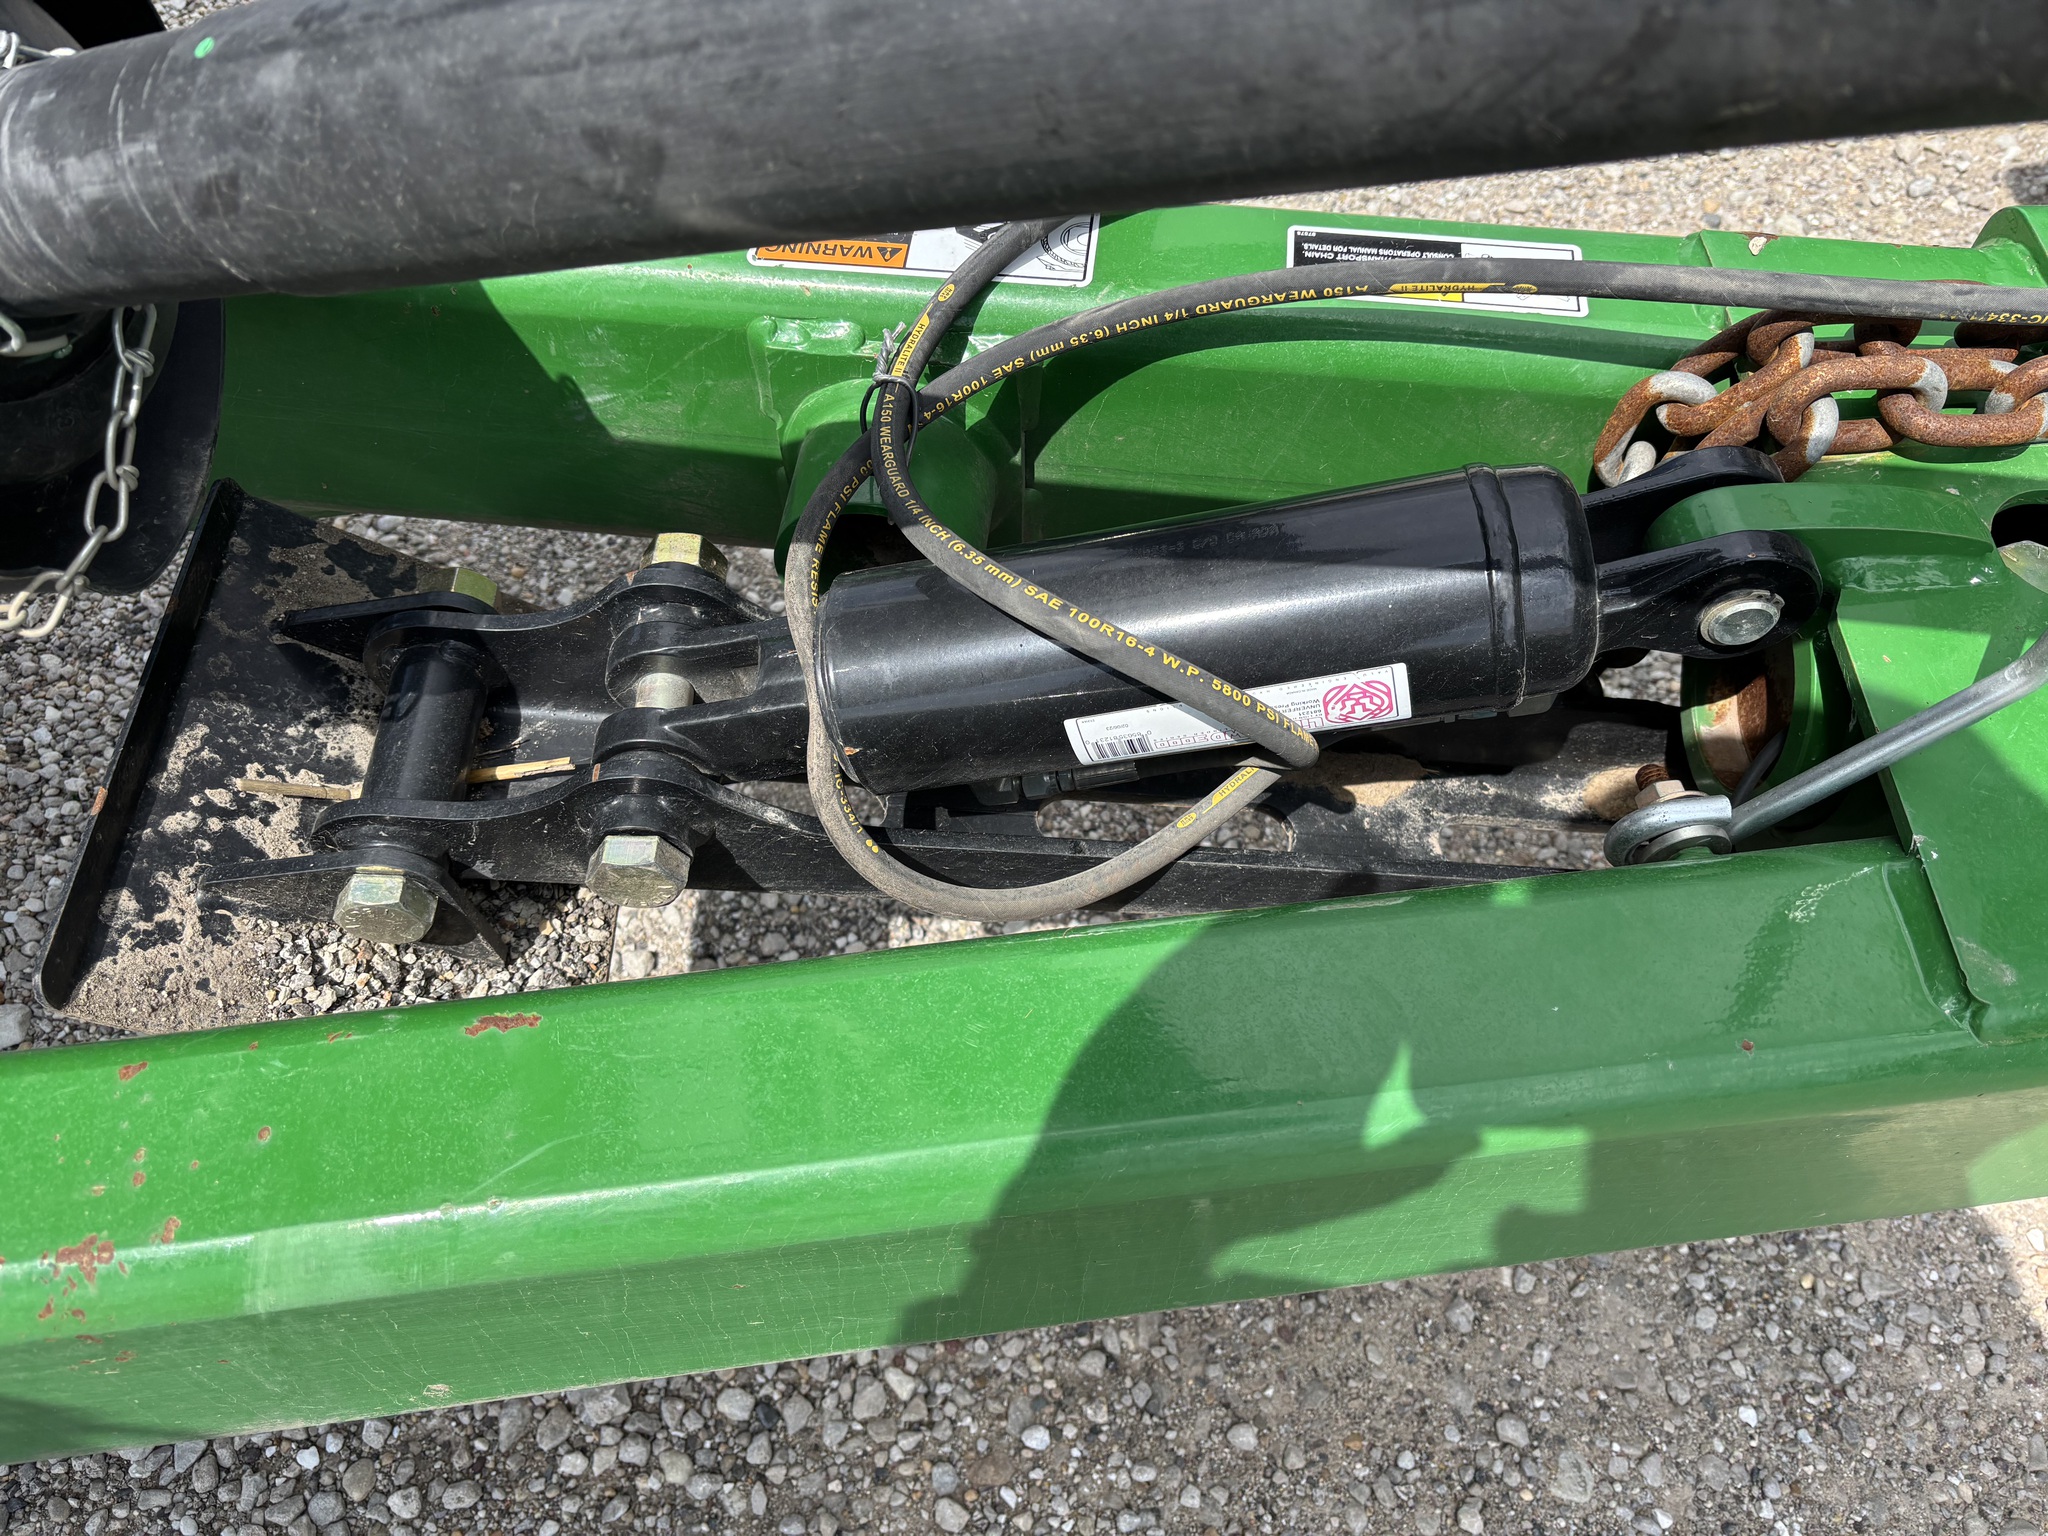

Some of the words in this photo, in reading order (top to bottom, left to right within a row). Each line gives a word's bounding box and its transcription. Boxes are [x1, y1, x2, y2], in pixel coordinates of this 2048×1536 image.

[1302, 243, 1332, 252] DETAILS.
[1333, 245, 1348, 253] FOR
[1349, 246, 1378, 255] MANUAL
[1379, 248, 1421, 258] OPERATORS
[1412, 284, 1476, 292] HYDRALITE
[1164, 308, 1189, 322] 1/4
[1195, 289, 1317, 316] WEARGUARD
[1070, 325, 1110, 348] (6.35
[1116, 314, 1159, 334] INCH
[896, 322, 926, 366] HYDRALITE
[1029, 341, 1065, 362] mm)
[991, 356, 1025, 380] SAE
[880, 393, 895, 423] A150
[923, 375, 988, 421] 100R16-4
[879, 426, 910, 498] WEARGUARD
[843, 475, 859, 503] PSI
[905, 499, 924, 515] 1/4
[815, 501, 842, 555] FLAME
[918, 515, 952, 541] INCH
[947, 539, 986, 565] (6.35
[810, 557, 820, 608] RESIS
[984, 563, 1023, 588] mm)
[1024, 584, 1064, 611] SAE
[1068, 607, 1156, 658] 100R16-4
[1161, 652, 1205, 683] W.P.
[1211, 678, 1252, 707] 5800
[1290, 698, 1320, 708] Working
[1256, 702, 1280, 724] PSI
[1279, 704, 1321, 714] UNVERFER
[1283, 719, 1315, 747] FLAME
